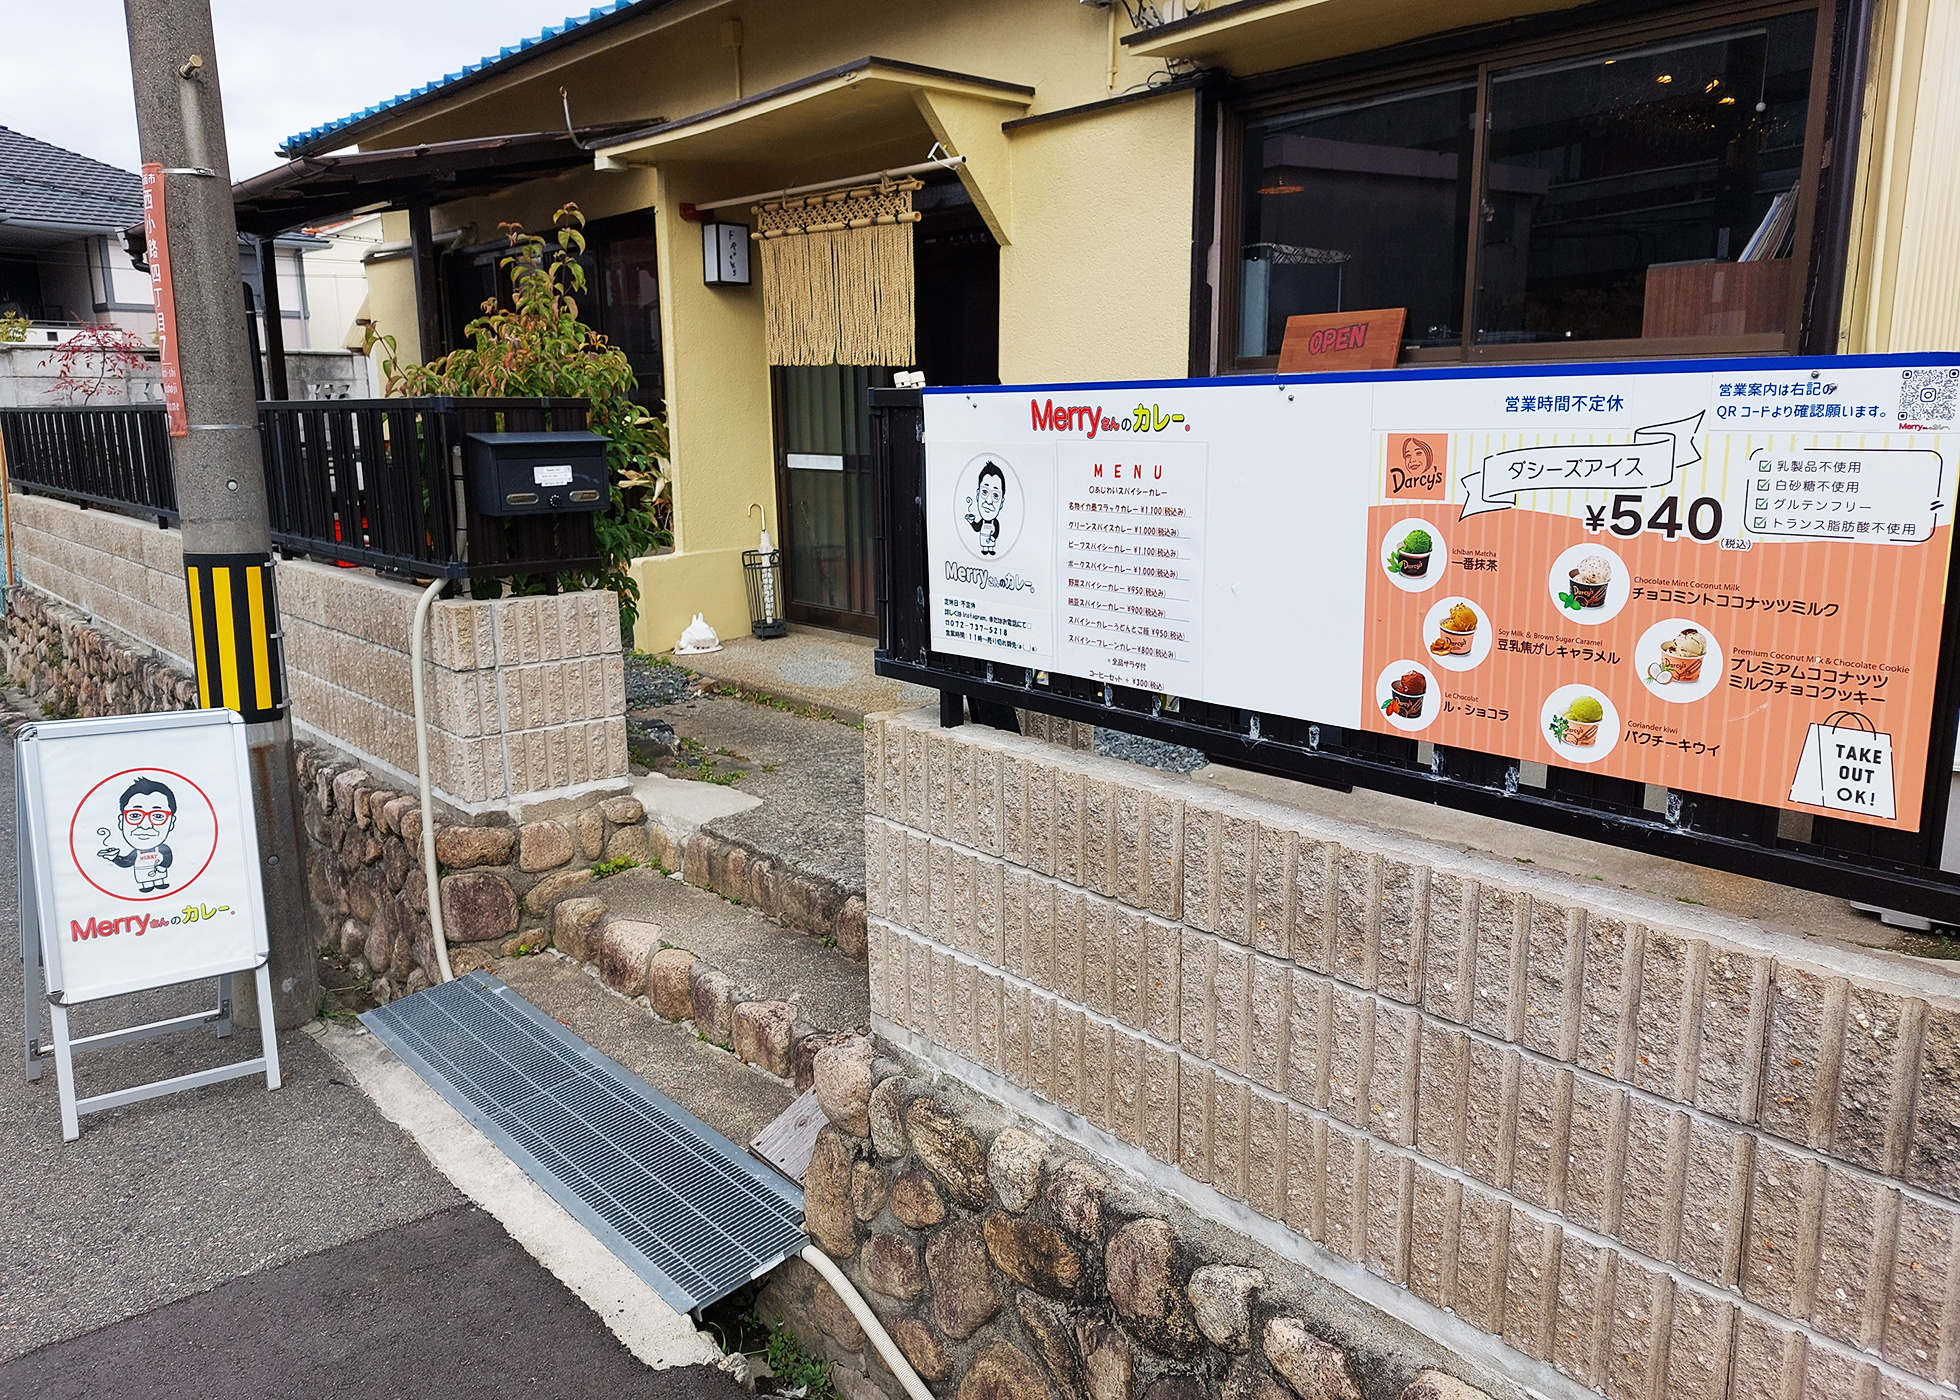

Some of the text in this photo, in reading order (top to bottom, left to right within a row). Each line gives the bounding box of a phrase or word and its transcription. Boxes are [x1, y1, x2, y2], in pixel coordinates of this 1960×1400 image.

[1308, 322, 1369, 355] OPEN
[1504, 394, 1624, 413] 営業時間不定休
[1508, 457, 1644, 480] ダシーズアイス
[1776, 460, 1862, 474] 乳製品不使用
[1389, 466, 1443, 493] Darcy's
[1775, 479, 1859, 494] 白砂糖不使用
[1773, 498, 1872, 512] グルテンフリー
[1585, 494, 1723, 541] ¥540
[1773, 518, 1916, 536] トランス脂肪酸不使用
[1452, 548, 1497, 558] Ichiban Matcha
[1720, 537, 1751, 551] (税込)
[1451, 557, 1498, 572] 一番抹茶
[1634, 576, 1740, 592] Chocolate Mint Coconut Milk
[1632, 587, 1839, 617] チョコミントココナッツミルク
[1498, 628, 1510, 637] Soy
[1533, 632, 1554, 641] Brown
[1555, 634, 1574, 644] Sugar
[1575, 637, 1603, 647] Caramel
[1497, 638, 1621, 665] 豆乳焦がしキャラメル
[1732, 647, 1768, 658] Premium
[1770, 651, 1804, 662] Coconut
[1825, 657, 1832, 665] &
[1833, 658, 1877, 670] Chocolate
[1879, 663, 1910, 674] Cookie
[1731, 658, 1889, 689] プレミアムココナッツ
[1444, 691, 1479, 703] Le Chocolat
[1729, 674, 1886, 705] ミルクチョコクッキー
[1443, 703, 1509, 721] ル・ショコラ
[1627, 720, 1678, 734] Coriander kiwi
[1835, 743, 1882, 765] TAKE
[1838, 765, 1875, 784] OUT
[1836, 786, 1876, 806] OK!
